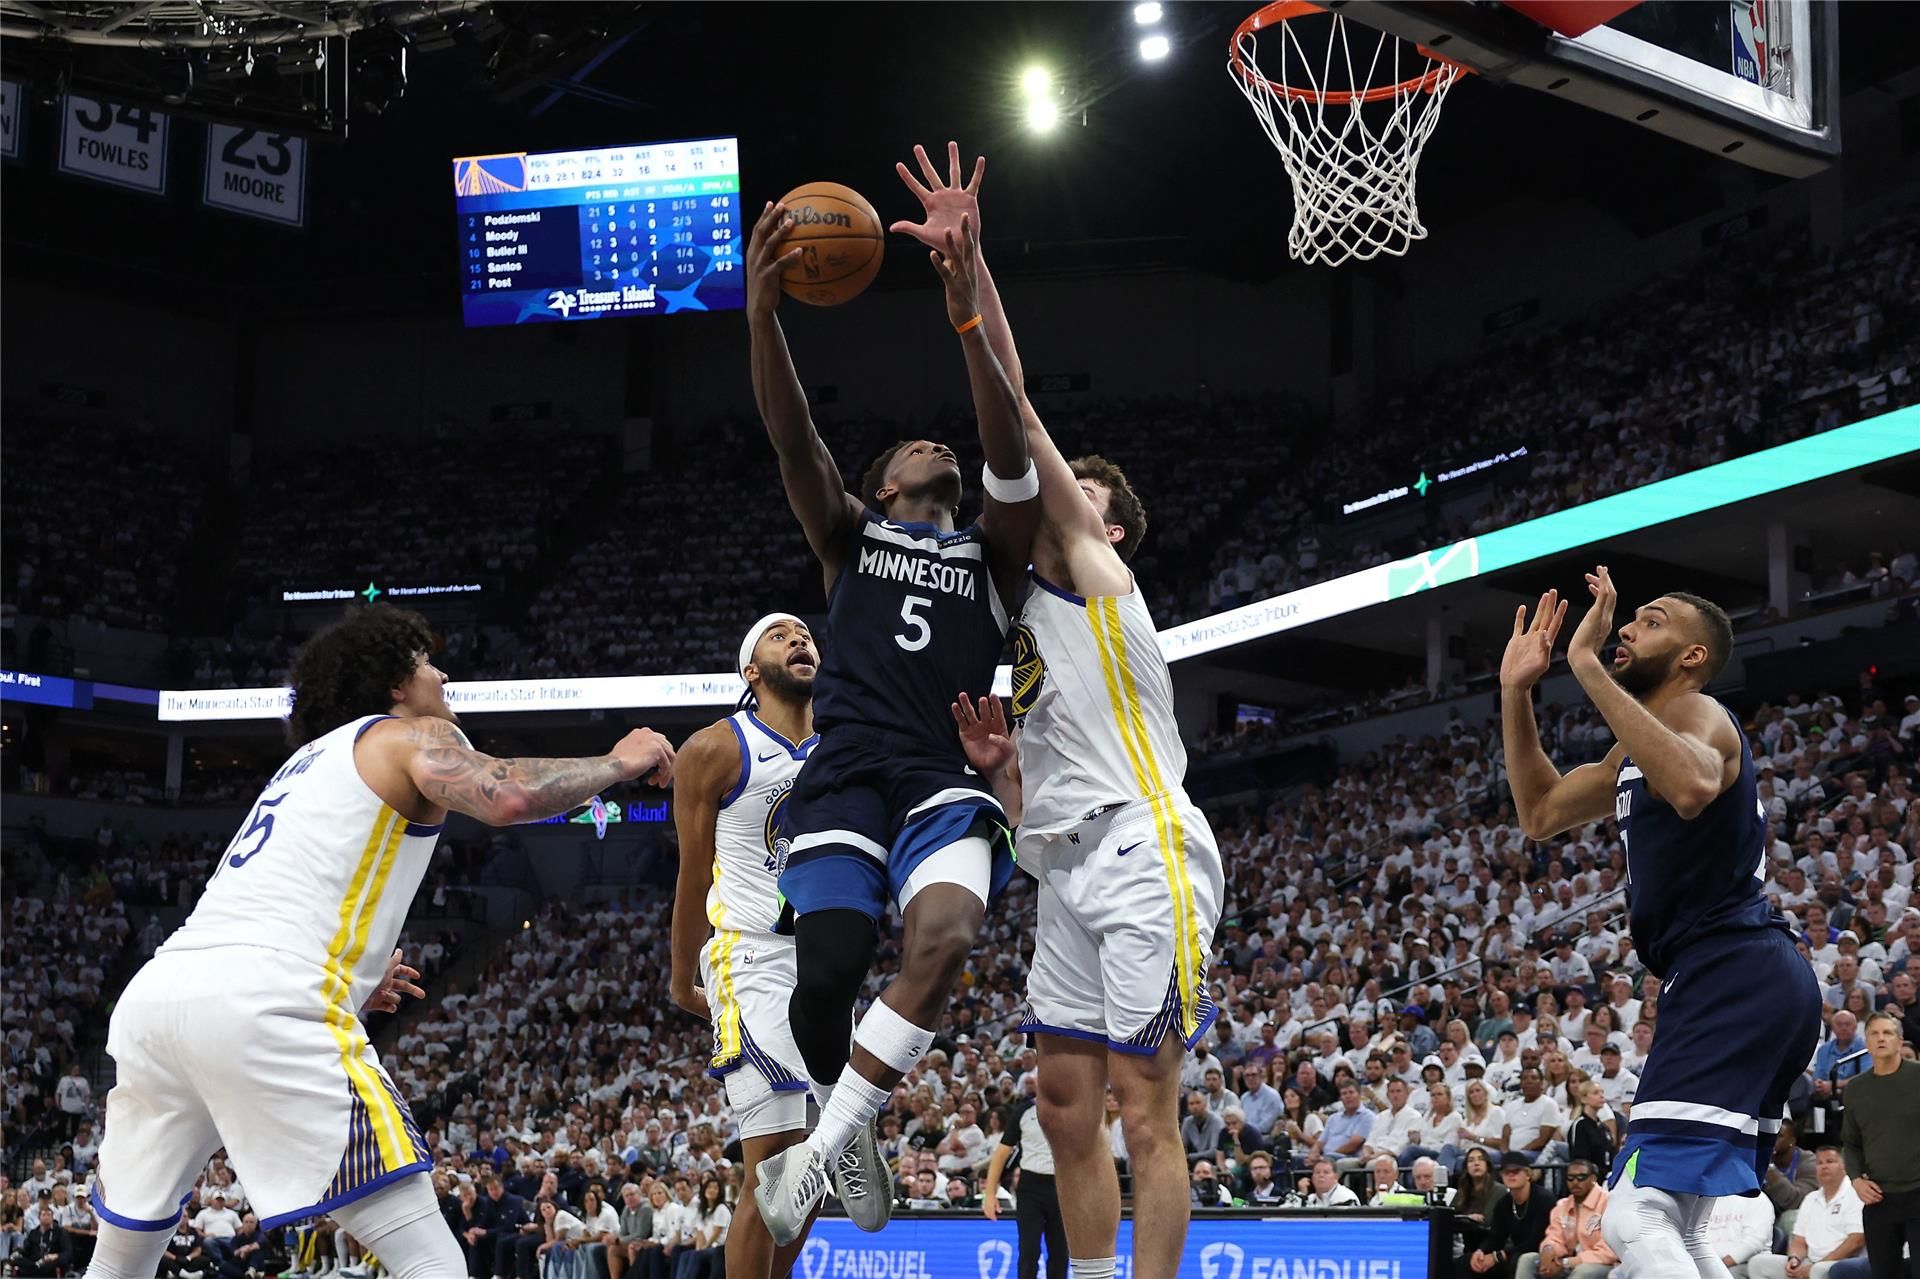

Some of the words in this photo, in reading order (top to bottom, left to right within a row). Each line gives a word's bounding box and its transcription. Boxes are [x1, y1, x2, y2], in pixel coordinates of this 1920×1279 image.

[1737, 56, 1755, 79] NBA
[78, 137, 149, 171] FOWLES
[221, 128, 292, 176] 23
[635, 152, 650, 160] AST
[613, 168, 624, 176] 32
[640, 165, 651, 174] 16
[665, 164, 676, 172] 14
[694, 162, 703, 170] 11
[224, 172, 286, 203] MOORE
[469, 217, 475, 227] 2
[484, 212, 541, 226] Podziemski
[588, 207, 600, 217] 21
[608, 205, 616, 216] 5
[628, 204, 635, 214] 4
[647, 202, 655, 213] 2
[672, 200, 697, 211] 8/15
[710, 196, 730, 207] 4/6
[485, 230, 519, 242] Moody
[591, 223, 599, 233] 6
[608, 221, 616, 232] 0
[629, 220, 637, 230] 0
[648, 219, 656, 229] 0
[672, 216, 692, 227] 2/3
[713, 212, 729, 224] 1/1
[468, 248, 480, 258] 10
[486, 245, 517, 257] Butler
[517, 244, 528, 255] III
[590, 239, 602, 249] 12
[609, 237, 617, 248] 3
[630, 236, 637, 246] 4
[649, 234, 657, 245] 2
[712, 229, 731, 240] 0/2
[470, 264, 481, 273] 15
[487, 261, 522, 273] Santos
[593, 255, 600, 265] 2
[610, 253, 618, 263] 4
[631, 251, 638, 262] 0
[651, 250, 657, 261] 1
[676, 248, 694, 258] 1/4
[713, 244, 732, 256] 0/3
[471, 280, 482, 289] 21
[488, 277, 512, 288] Post
[594, 270, 601, 281] 3
[611, 268, 619, 279] 3
[631, 267, 639, 277] 0
[652, 266, 658, 277] 1
[676, 263, 694, 274] 1/3
[715, 260, 733, 272] 1/3
[576, 288, 621, 306] Treasure
[622, 284, 655, 302] Island
[622, 301, 656, 310] CASINO
[858, 546, 976, 601] MINNESOTA
[895, 594, 933, 652] 5
[18, 673, 41, 687] First
[446, 686, 508, 702] Minnesota
[510, 686, 536, 701] Star
[540, 684, 584, 700] Tribune
[679, 682, 700, 697] The
[167, 696, 187, 711] The
[189, 696, 248, 711] Minnesota
[249, 695, 274, 709] Star
[628, 801, 668, 823] Island
[832, 1249, 932, 1279] FANDUEL
